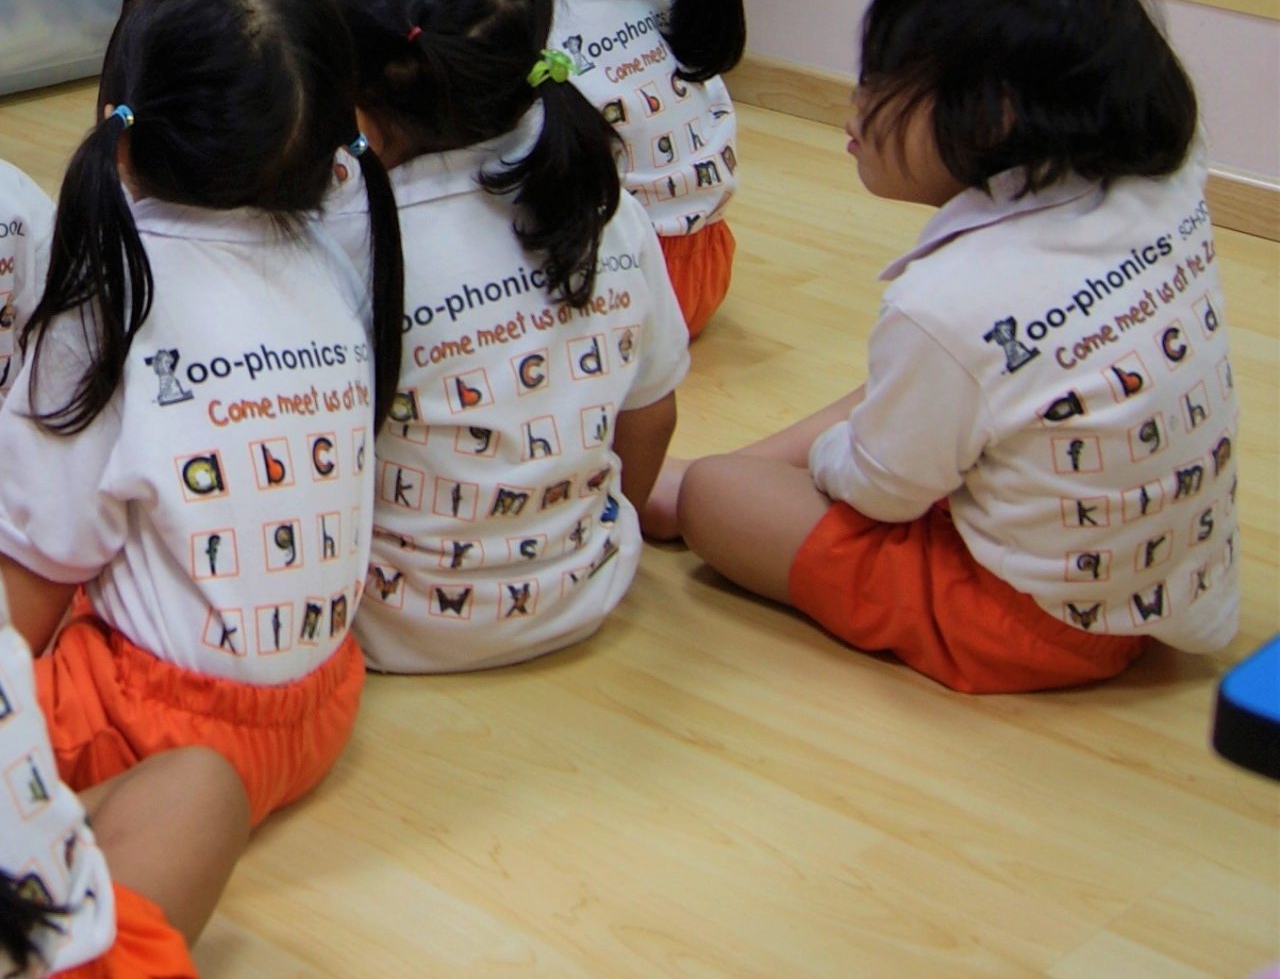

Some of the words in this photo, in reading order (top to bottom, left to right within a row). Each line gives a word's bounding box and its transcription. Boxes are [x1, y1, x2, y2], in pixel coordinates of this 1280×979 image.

[605, 57, 644, 84] Come
[640, 89, 660, 113] b
[658, 135, 674, 163] g
[688, 123, 704, 150] h
[695, 160, 721, 186] m
[599, 253, 641, 273] HOOL
[414, 336, 474, 368] Come
[477, 311, 526, 347] meet
[531, 307, 554, 330] us
[1055, 324, 1116, 370] Come
[1117, 287, 1158, 331] meet
[1156, 282, 1175, 303] us
[1173, 265, 1188, 292] at
[455, 377, 482, 409] b
[579, 338, 603, 375] d
[1043, 391, 1084, 421] a
[1111, 365, 1143, 396] b
[1204, 293, 1218, 333] d
[208, 397, 276, 427] Come
[278, 386, 320, 417] meet
[323, 390, 341, 412] us
[529, 424, 551, 458] h
[1067, 438, 1084, 471] f
[1139, 421, 1160, 453] g
[1186, 392, 1206, 424] h
[182, 453, 225, 495] a
[261, 443, 286, 484] b
[394, 469, 413, 507] k
[492, 488, 529, 517] m
[1078, 500, 1097, 526] k
[1175, 466, 1202, 500] m
[206, 534, 221, 575] f
[274, 524, 296, 565] g
[321, 516, 335, 559] h
[1146, 535, 1165, 567] r
[1198, 509, 1214, 540] s
[435, 588, 470, 615] w
[506, 584, 531, 618] x
[1133, 584, 1164, 620] w
[220, 616, 238, 654] k
